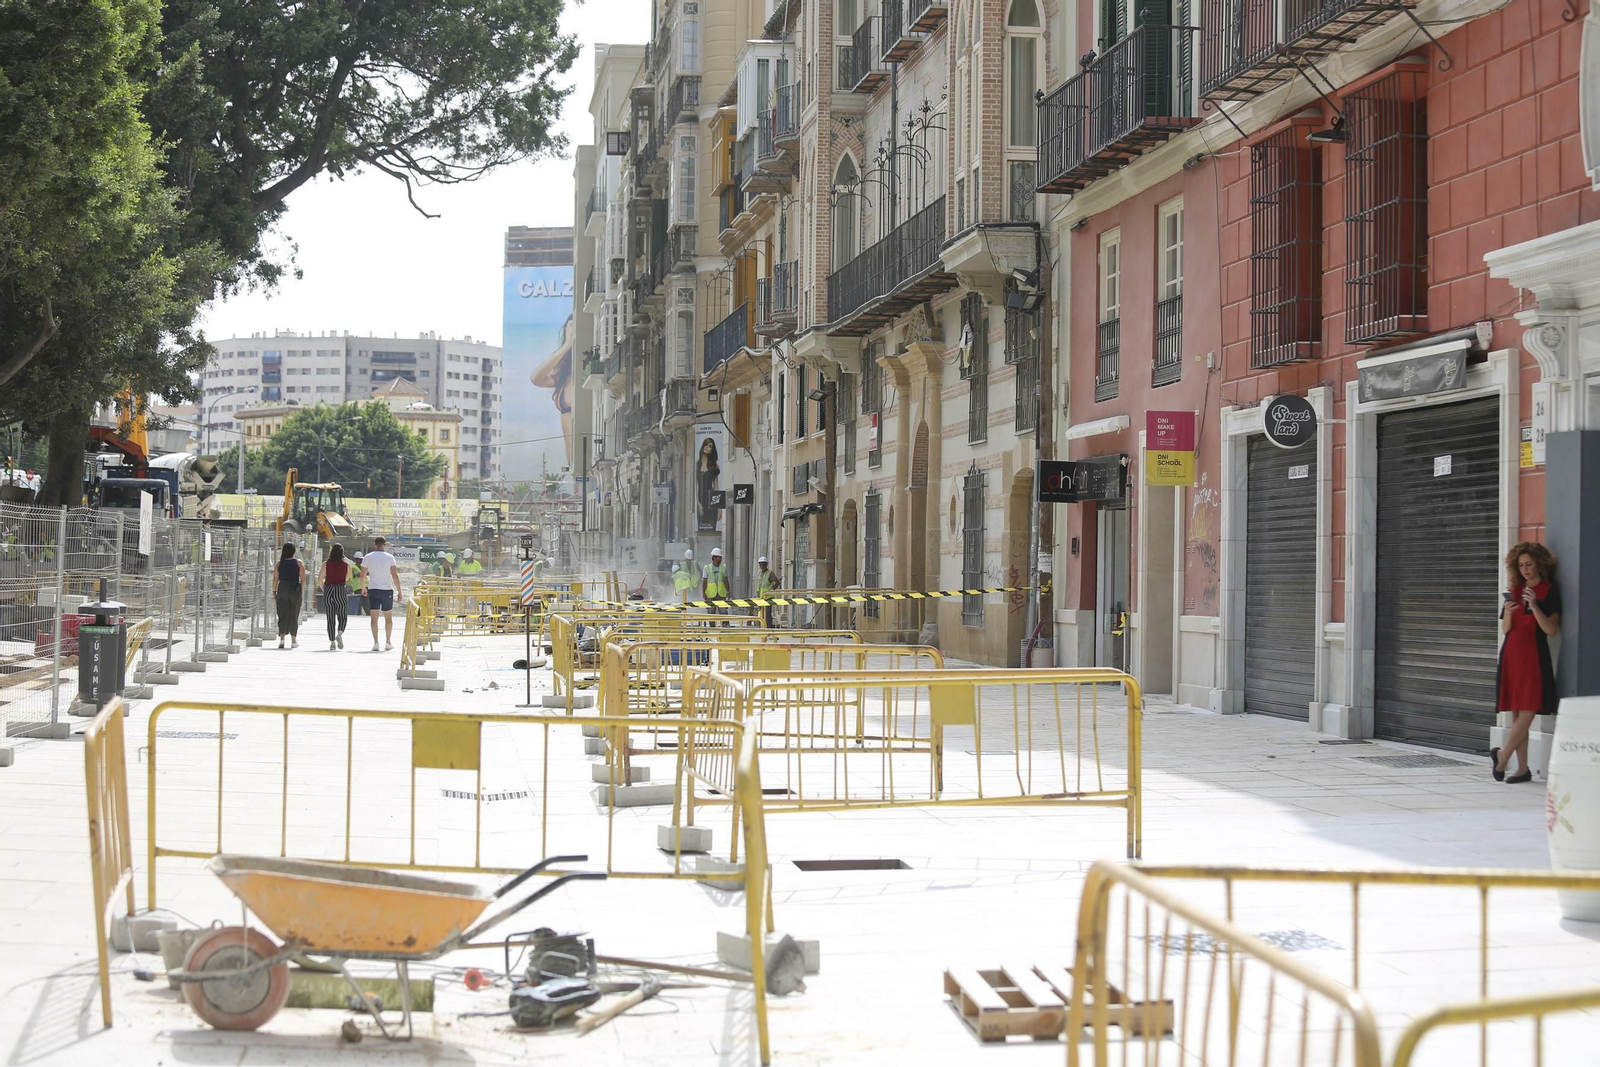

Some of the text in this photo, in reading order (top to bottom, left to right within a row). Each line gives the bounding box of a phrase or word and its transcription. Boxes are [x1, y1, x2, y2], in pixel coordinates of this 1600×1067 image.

[518, 279, 573, 298] CALZ
[1271, 404, 1311, 422] Sweet
[1536, 401, 1544, 416] 26
[1536, 429, 1544, 443] 28
[92, 640, 100, 695] ÚSAME
